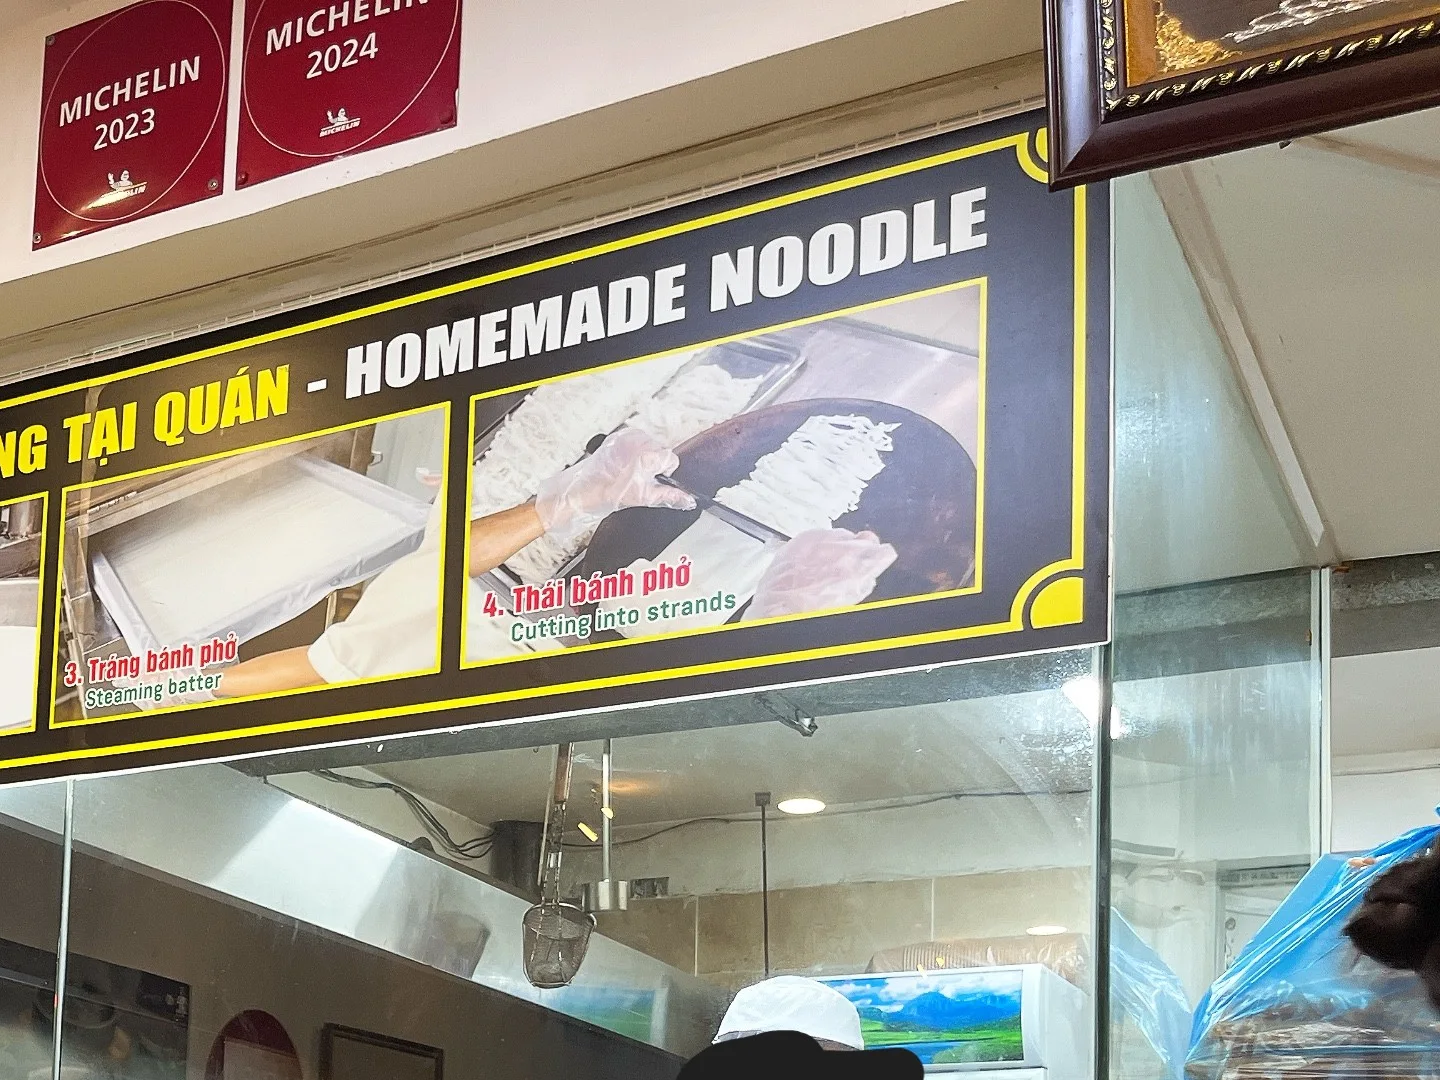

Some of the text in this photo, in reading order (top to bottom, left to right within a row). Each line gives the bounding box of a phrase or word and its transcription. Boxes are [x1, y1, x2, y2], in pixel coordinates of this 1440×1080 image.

[306, 32, 379, 79] 2024
[59, 55, 202, 127] MICHELIN
[94, 108, 155, 150] 2023
[319, 120, 361, 138] MICHELIN
[62, 400, 139, 465] TẠI
[153, 363, 290, 447] QUÁN
[343, 263, 688, 400] HOMEMADE
[708, 186, 989, 314] NOODLE
[482, 555, 692, 618] 4. Thái bánh phở
[511, 590, 737, 642] Cutting into strands
[64, 631, 240, 686] 3. Tráng bánh phở
[85, 672, 222, 708] Steaming batter
